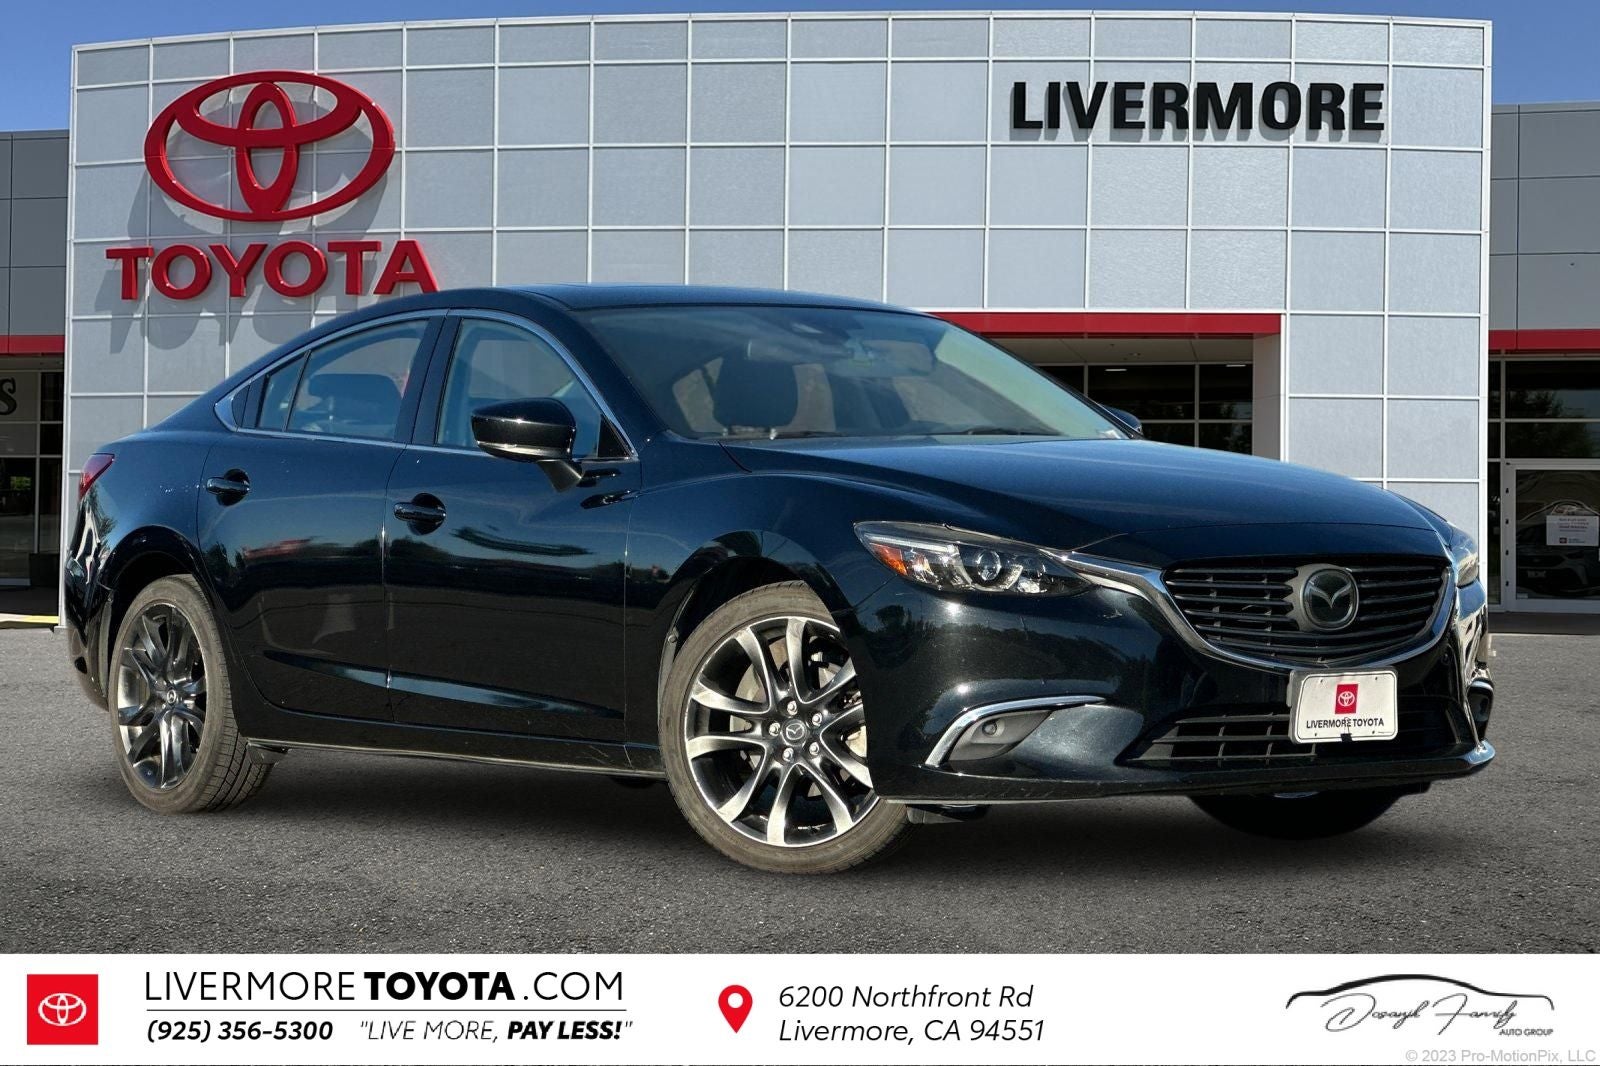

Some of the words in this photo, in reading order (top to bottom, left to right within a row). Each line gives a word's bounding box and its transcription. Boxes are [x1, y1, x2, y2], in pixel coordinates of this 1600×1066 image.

[1011, 80, 1386, 131] LIVERMORE
[106, 240, 440, 301] TOYOTA
[1306, 718, 1352, 729] LIVERMORE
[1352, 717, 1385, 728] TOYOTA
